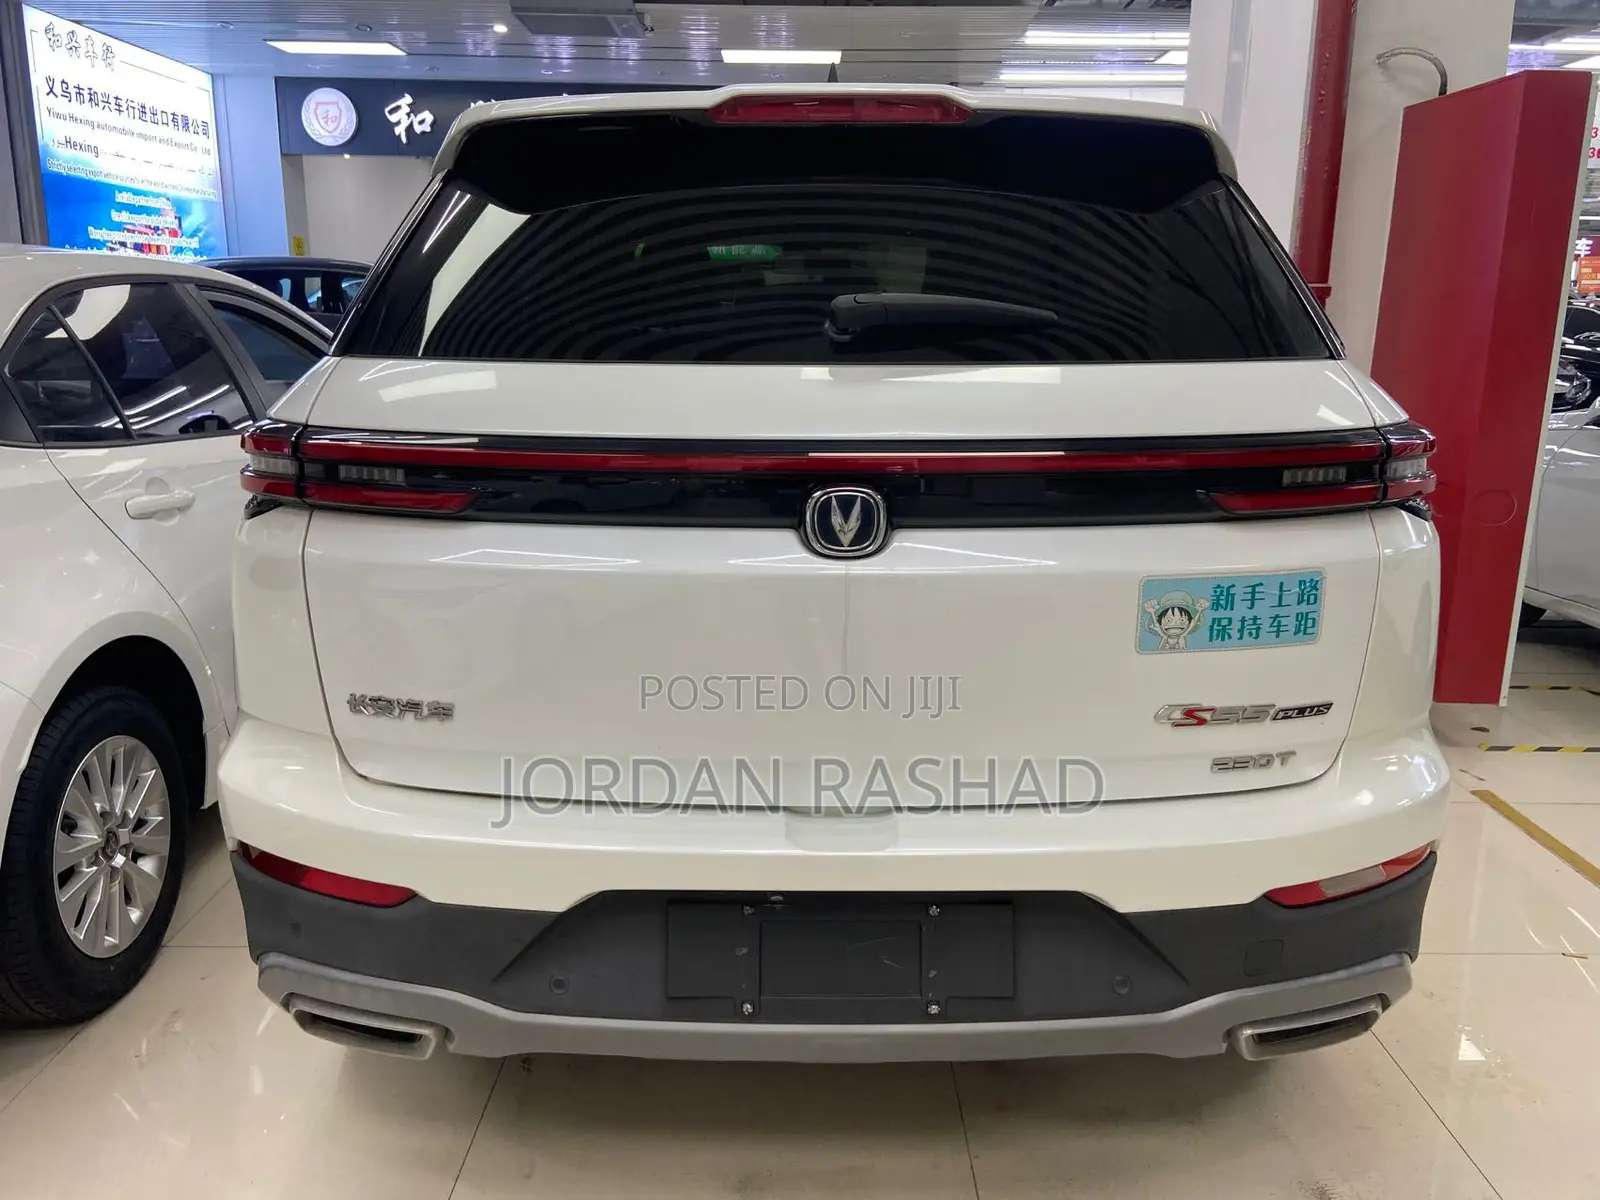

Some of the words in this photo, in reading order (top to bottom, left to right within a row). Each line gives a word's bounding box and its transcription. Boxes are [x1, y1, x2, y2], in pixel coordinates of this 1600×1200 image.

[45, 74, 210, 140] 义乌市和兴车行进出口有限公司
[46, 106, 67, 121] Yiwu
[68, 112, 95, 130] Hexing
[96, 121, 135, 137] automobile
[384, 93, 435, 145] 和
[64, 135, 99, 158] Hexing
[1209, 579, 1320, 612] 新手上路
[1207, 611, 1318, 643] 保持车距
[1153, 703, 1276, 728] CS55
[1273, 703, 1334, 721] PLUS
